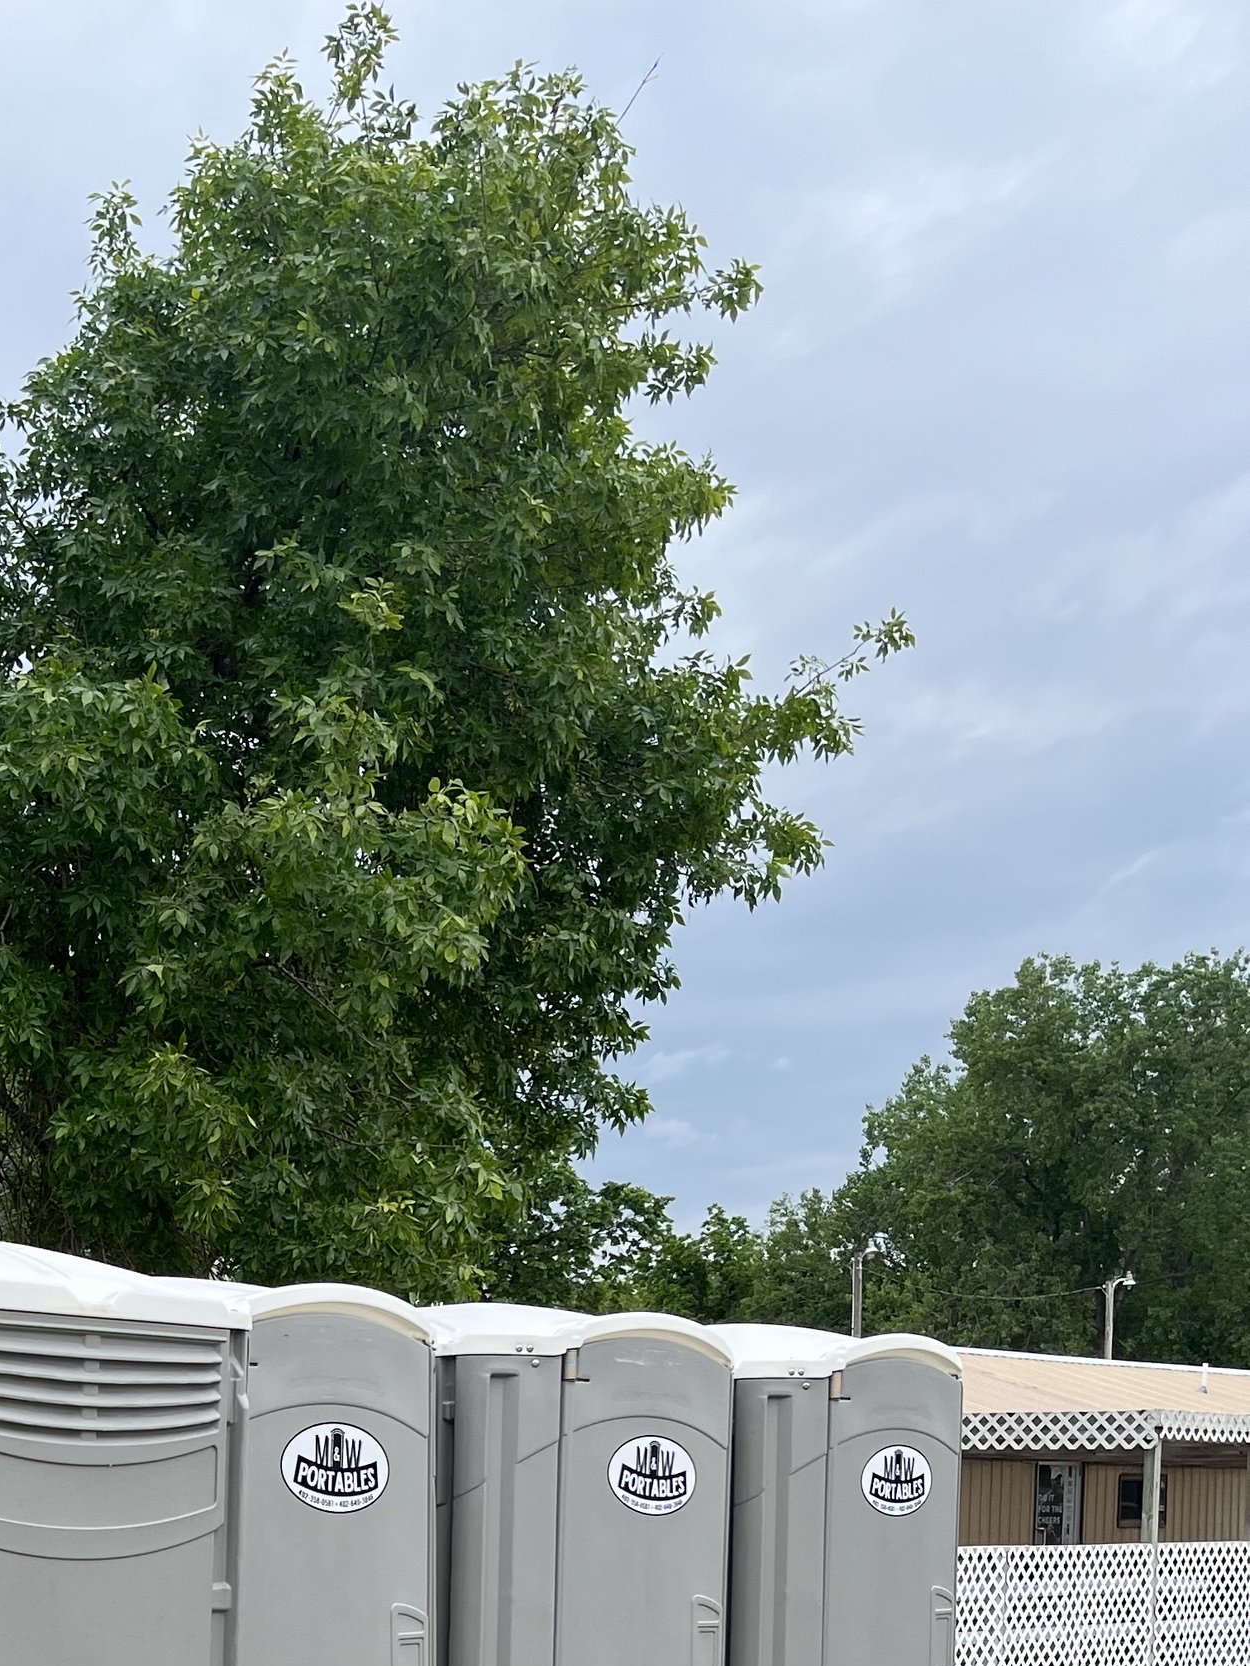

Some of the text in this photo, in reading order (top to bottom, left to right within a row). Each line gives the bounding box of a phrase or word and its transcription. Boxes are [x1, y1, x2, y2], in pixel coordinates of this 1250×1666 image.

[297, 1461, 376, 1493] PORTABLES
[620, 1469, 685, 1498] PORTABLES
[871, 1477, 924, 1500] PORTABLES
